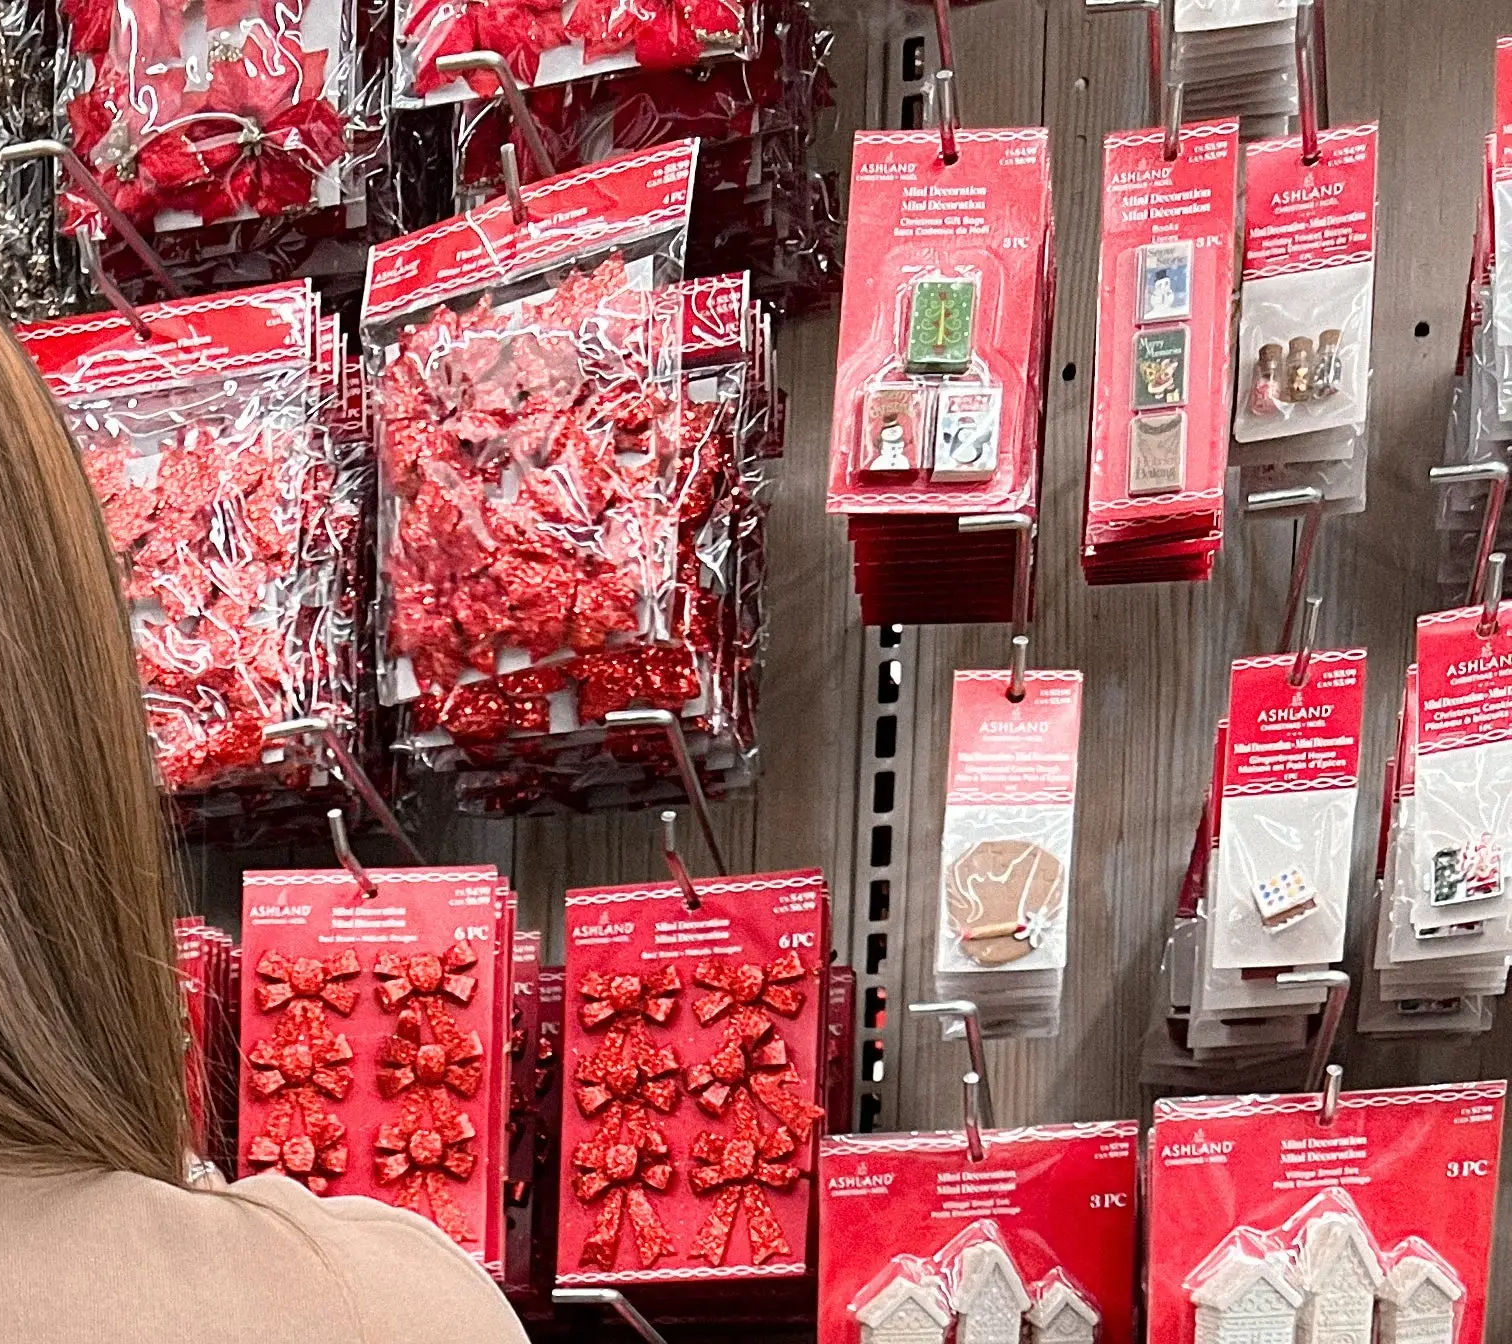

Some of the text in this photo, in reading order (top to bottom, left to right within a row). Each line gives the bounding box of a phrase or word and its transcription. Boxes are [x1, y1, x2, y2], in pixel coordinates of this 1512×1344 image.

[860, 163, 916, 174] ASHLAND
[1111, 168, 1171, 184] ASHLAND
[670, 188, 686, 202] PC
[903, 186, 986, 196] Mini Decoration
[1122, 189, 1211, 207] Mini Decoration
[1271, 182, 1345, 206] ASHLAND
[902, 201, 927, 210] Mini
[1122, 209, 1148, 222] Mini
[1013, 237, 1028, 248] PC
[1207, 235, 1222, 248] PC
[1447, 654, 1512, 677] ASHLAN
[1257, 705, 1332, 723] ASHLAND
[978, 721, 1049, 733] ASHLAND
[249, 905, 311, 917] ASHLAND
[572, 922, 635, 938] ASHLAND
[655, 919, 730, 932] Mini Decoration
[454, 926, 488, 940] 6 PC
[655, 934, 677, 944] Mini
[778, 932, 814, 949] 6 PC
[1161, 1141, 1233, 1158] ASHLAND
[1281, 1135, 1367, 1150] Mini Decoration
[1280, 1152, 1305, 1164] Mini
[1446, 1160, 1488, 1177] 3 PC
[828, 1173, 893, 1189] ASHLAND
[937, 1170, 1016, 1183] Mini Decoration
[937, 1185, 960, 1195] Mini
[1090, 1193, 1127, 1208] 3 PC
